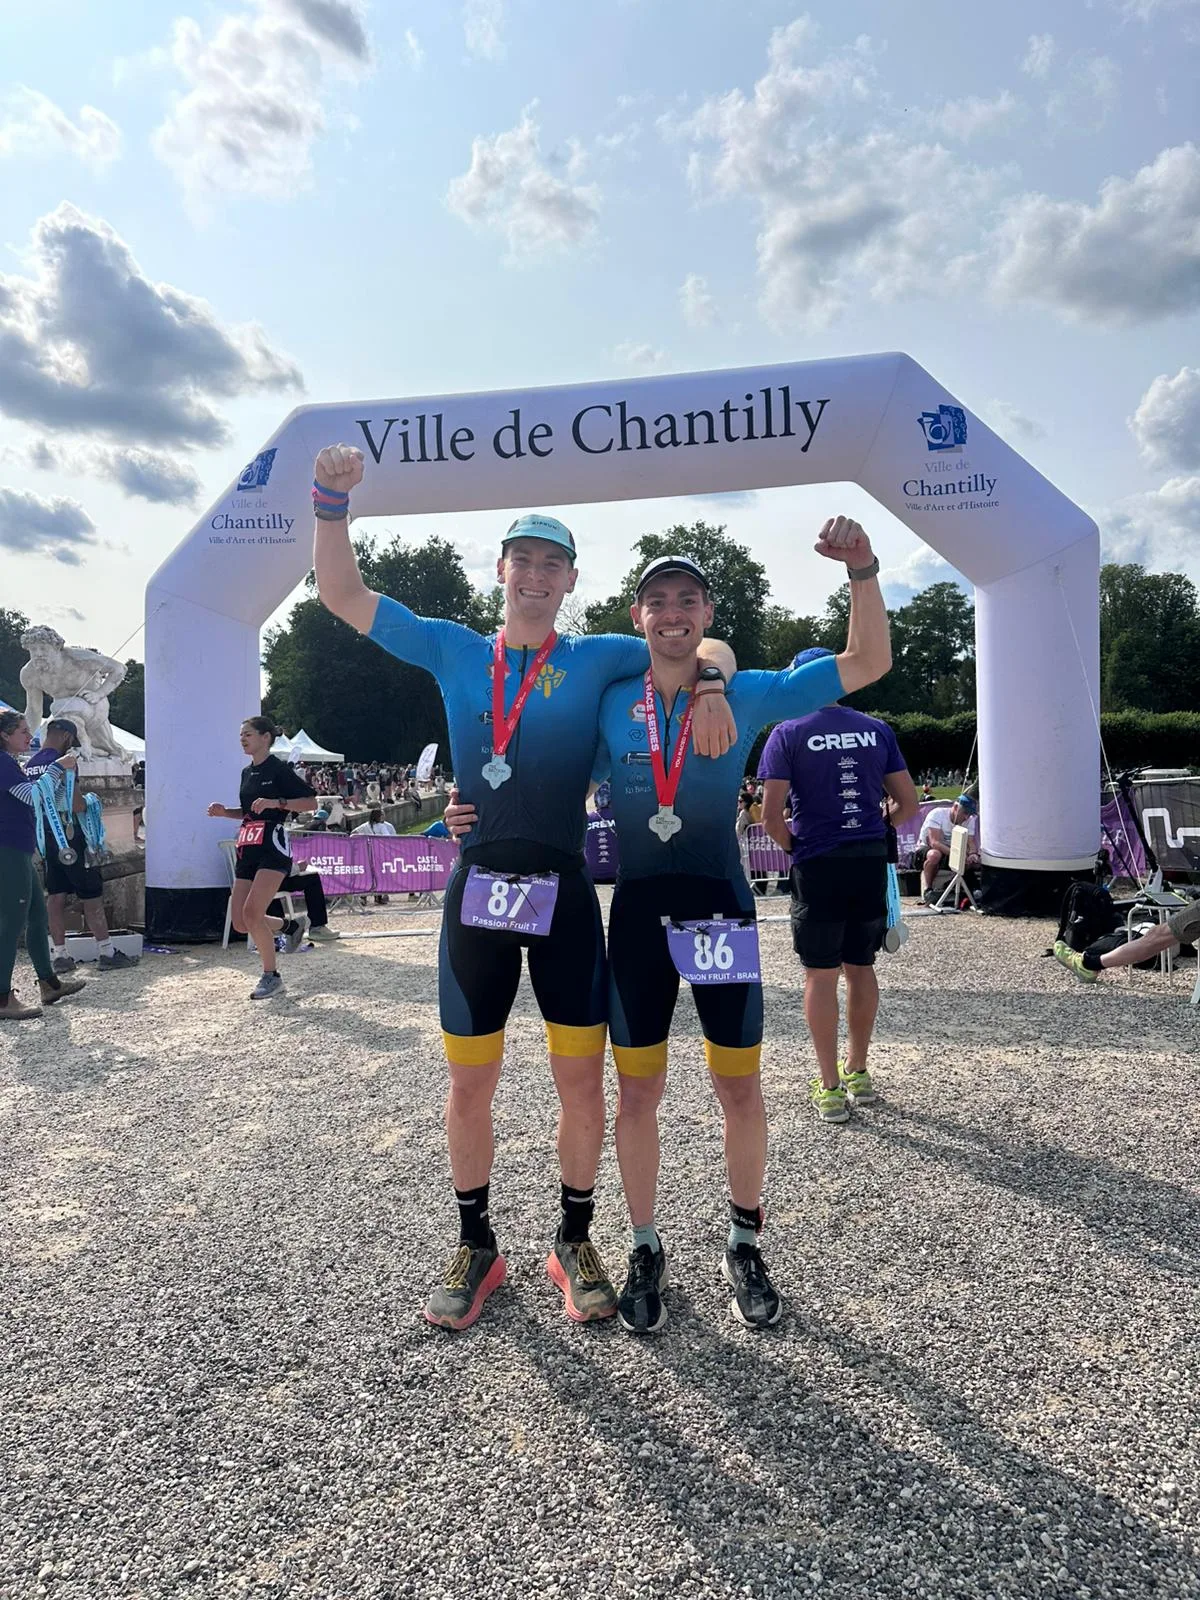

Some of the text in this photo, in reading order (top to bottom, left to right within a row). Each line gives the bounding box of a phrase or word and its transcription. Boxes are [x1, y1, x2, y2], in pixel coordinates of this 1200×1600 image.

[355, 385, 830, 465] Ville de Chantilly
[924, 458, 970, 473] Ville de
[903, 473, 997, 497] Chantilly
[231, 498, 268, 509] Ville de
[905, 502, 922, 511] Ville
[946, 503, 955, 511] et
[957, 500, 1000, 510] d'Histoire
[211, 512, 295, 535] Chantilly
[208, 536, 225, 544] Ville
[645, 683, 655, 712] RACE
[647, 713, 660, 752] SERIES
[807, 731, 877, 751] CREW
[310, 856, 344, 866] CASTLE
[334, 865, 364, 875] SERIES
[487, 880, 532, 919] 87
[472, 916, 538, 931] Passion Fruit T
[694, 933, 734, 970] 86
[737, 972, 759, 980] BRAM
